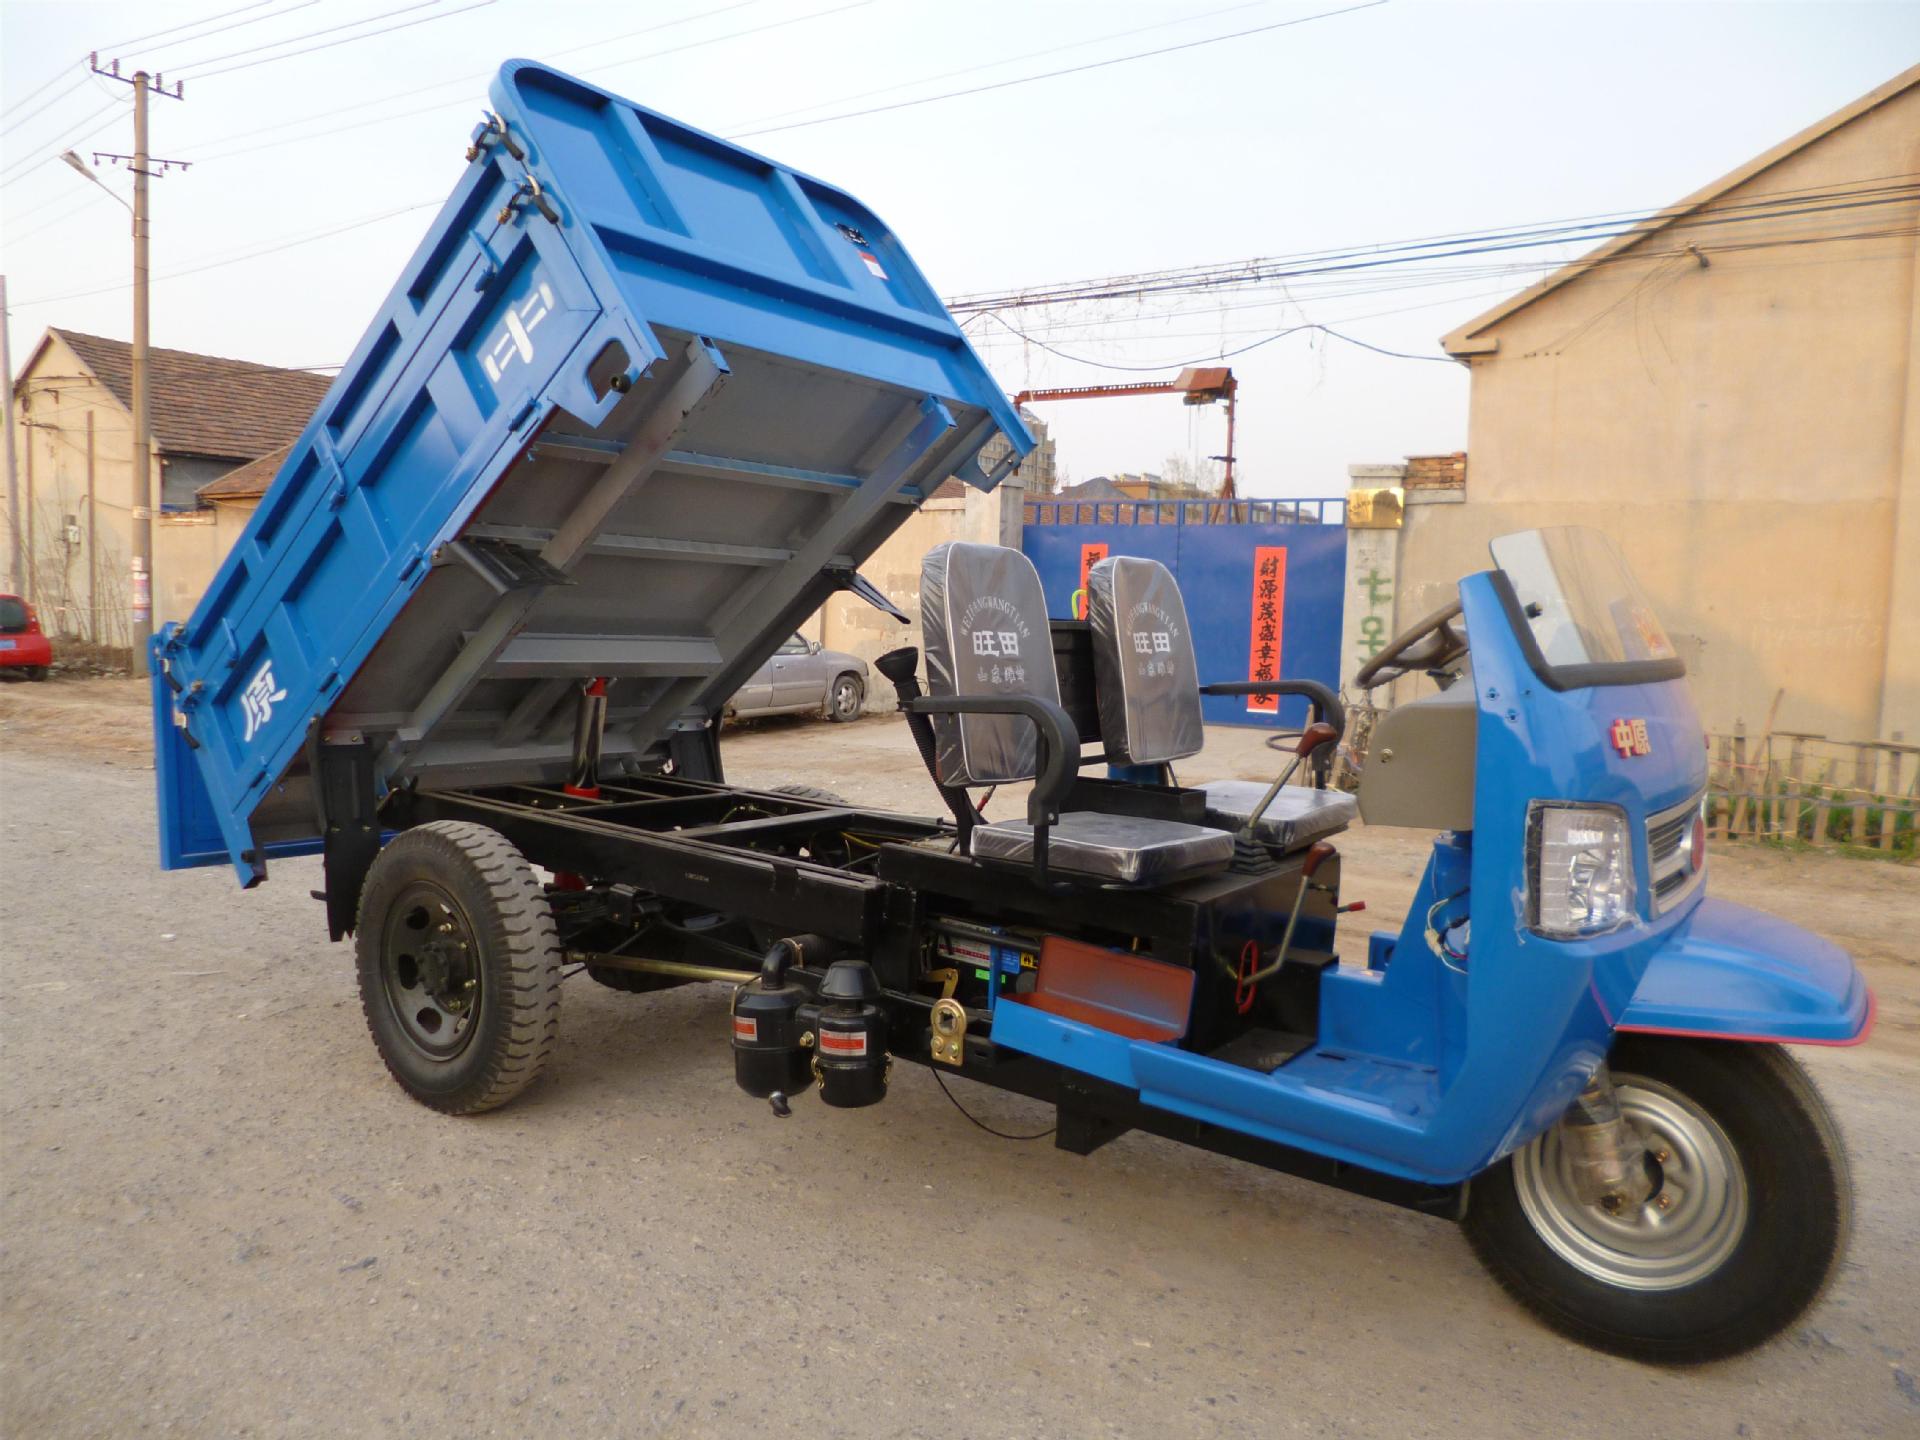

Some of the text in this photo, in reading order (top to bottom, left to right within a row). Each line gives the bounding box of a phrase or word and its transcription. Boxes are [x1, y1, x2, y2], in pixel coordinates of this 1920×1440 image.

[484, 281, 555, 384] 中
[972, 630, 1019, 657] 旺田
[1133, 631, 1171, 655] 旺田
[240, 658, 288, 742] 原
